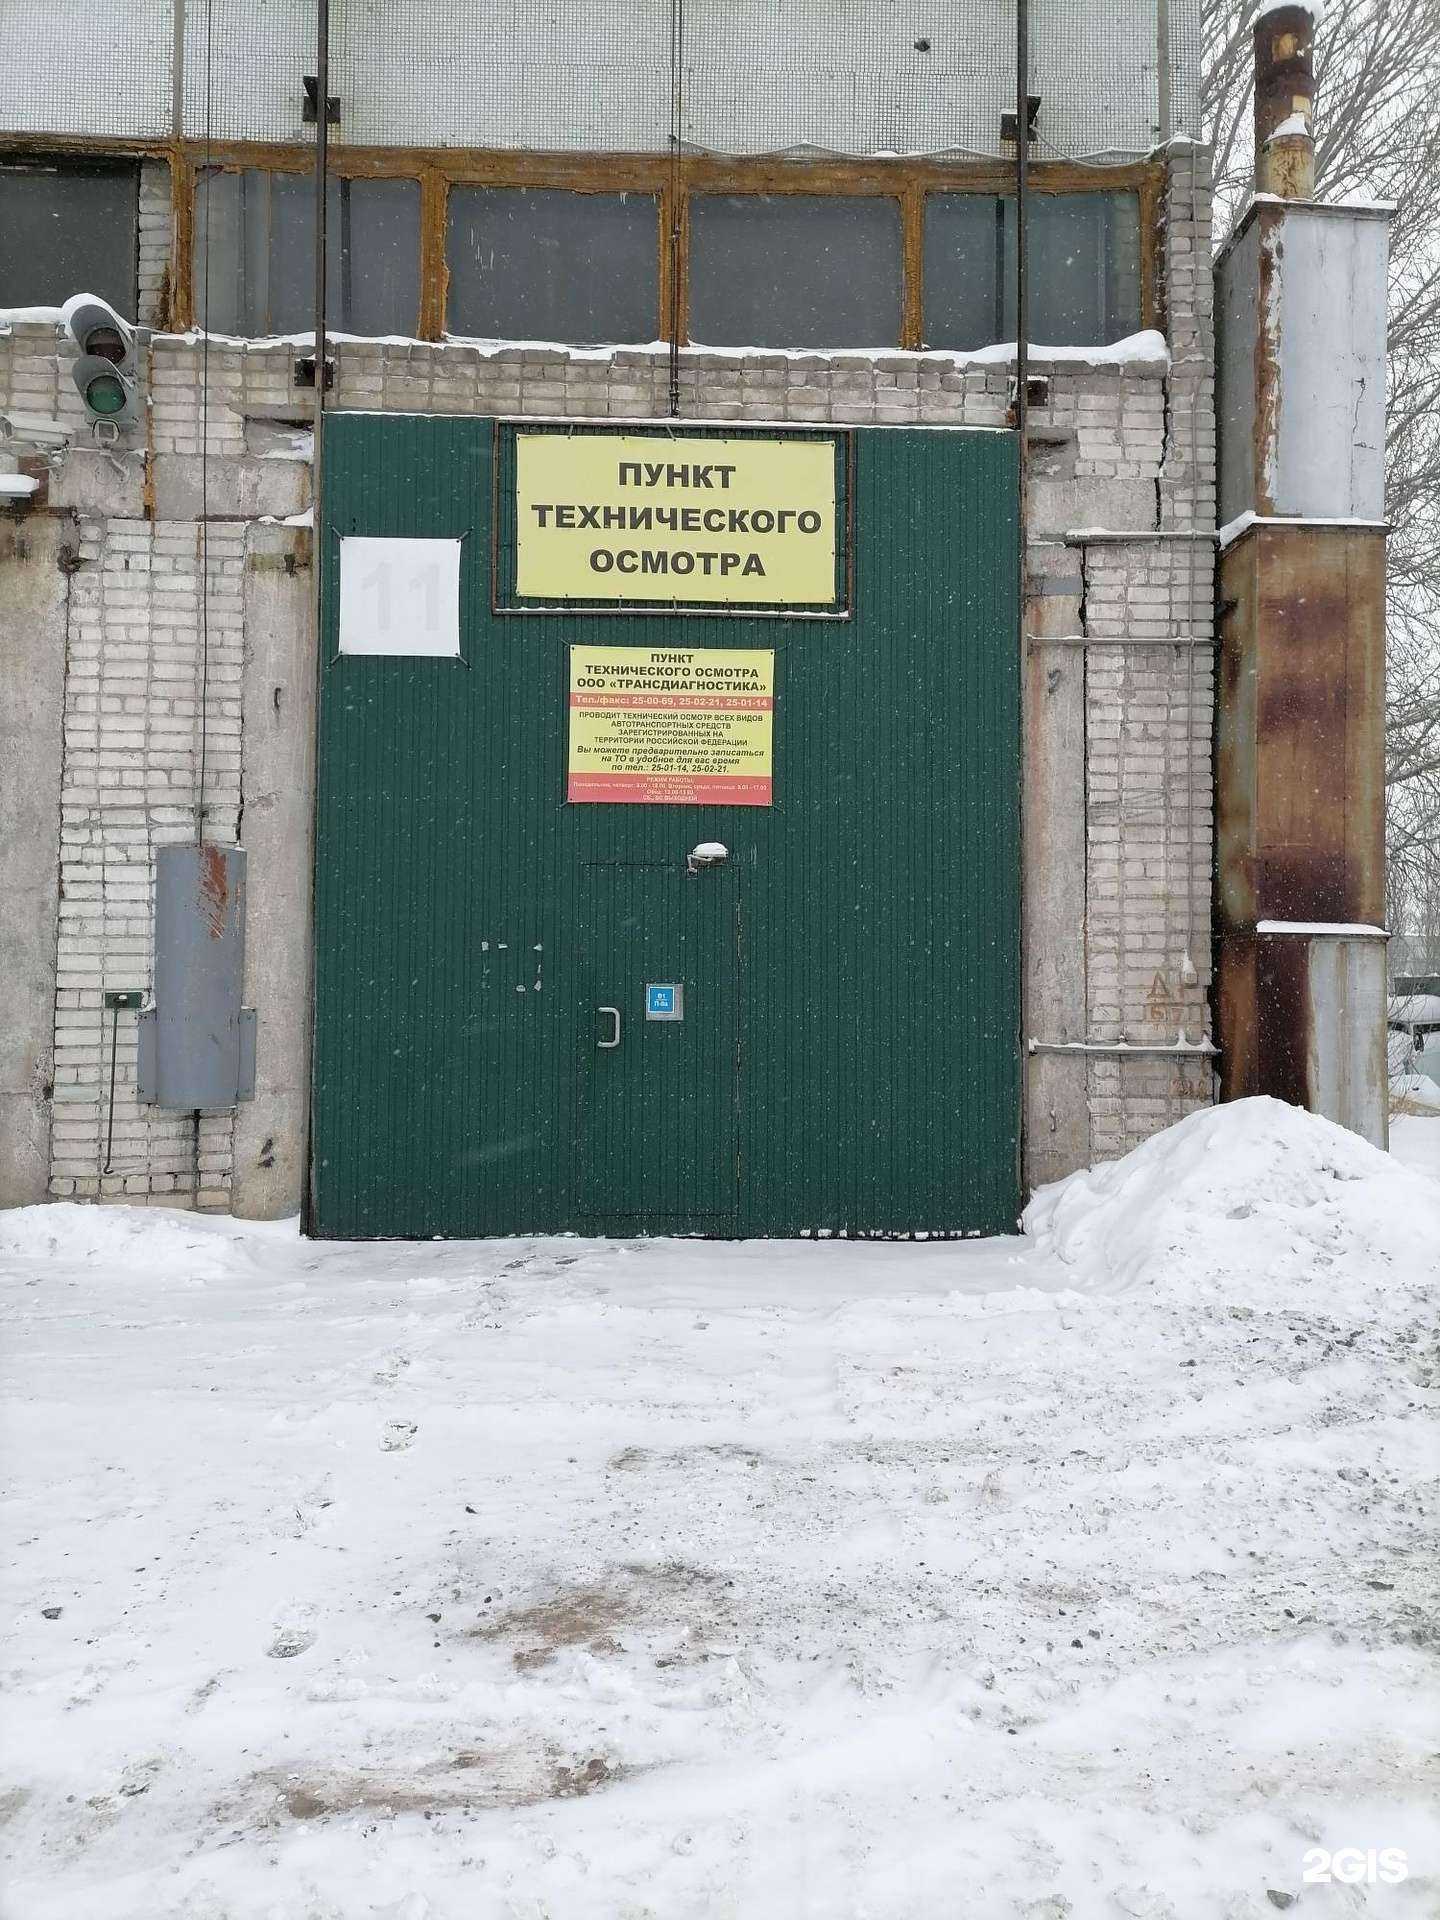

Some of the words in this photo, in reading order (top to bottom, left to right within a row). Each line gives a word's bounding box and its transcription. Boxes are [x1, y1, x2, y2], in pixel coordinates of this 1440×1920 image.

[618, 462, 736, 489] ПУНКТ
[531, 504, 822, 534] ТЕХНИЧЕСКОГО
[589, 549, 766, 576] ОСМОТРА
[361, 561, 440, 631] 11
[651, 653, 694, 663] ПУНКТ
[585, 665, 691, 676] ТЕХНИЧЕСКОГО
[695, 668, 759, 678] ОСМОТРА
[577, 678, 605, 687] ООО
[609, 679, 766, 691] «ТРАНСДИАГНОСТИКА»
[576, 695, 629, 705] Тел./факс:
[579, 711, 620, 719] ПРОВОДИТ
[623, 712, 678, 720] ТЕХНИЧЕСКИЙ
[680, 713, 712, 721] ОСМОТР
[611, 720, 694, 729] АВТОТРАНСПОРТНЫХ
[696, 722, 731, 730] СРЕДСТВ
[618, 729, 711, 737] ЗАРЕГИСТРИРОВАННЫХ
[594, 736, 644, 744] ТЕРРИТОРИИ
[647, 737, 699, 745] РОССИЙСКОЙ
[701, 738, 748, 746] ФЕДЕРАЦИИ
[632, 747, 709, 756] предварительно
[710, 749, 764, 757] записаться
